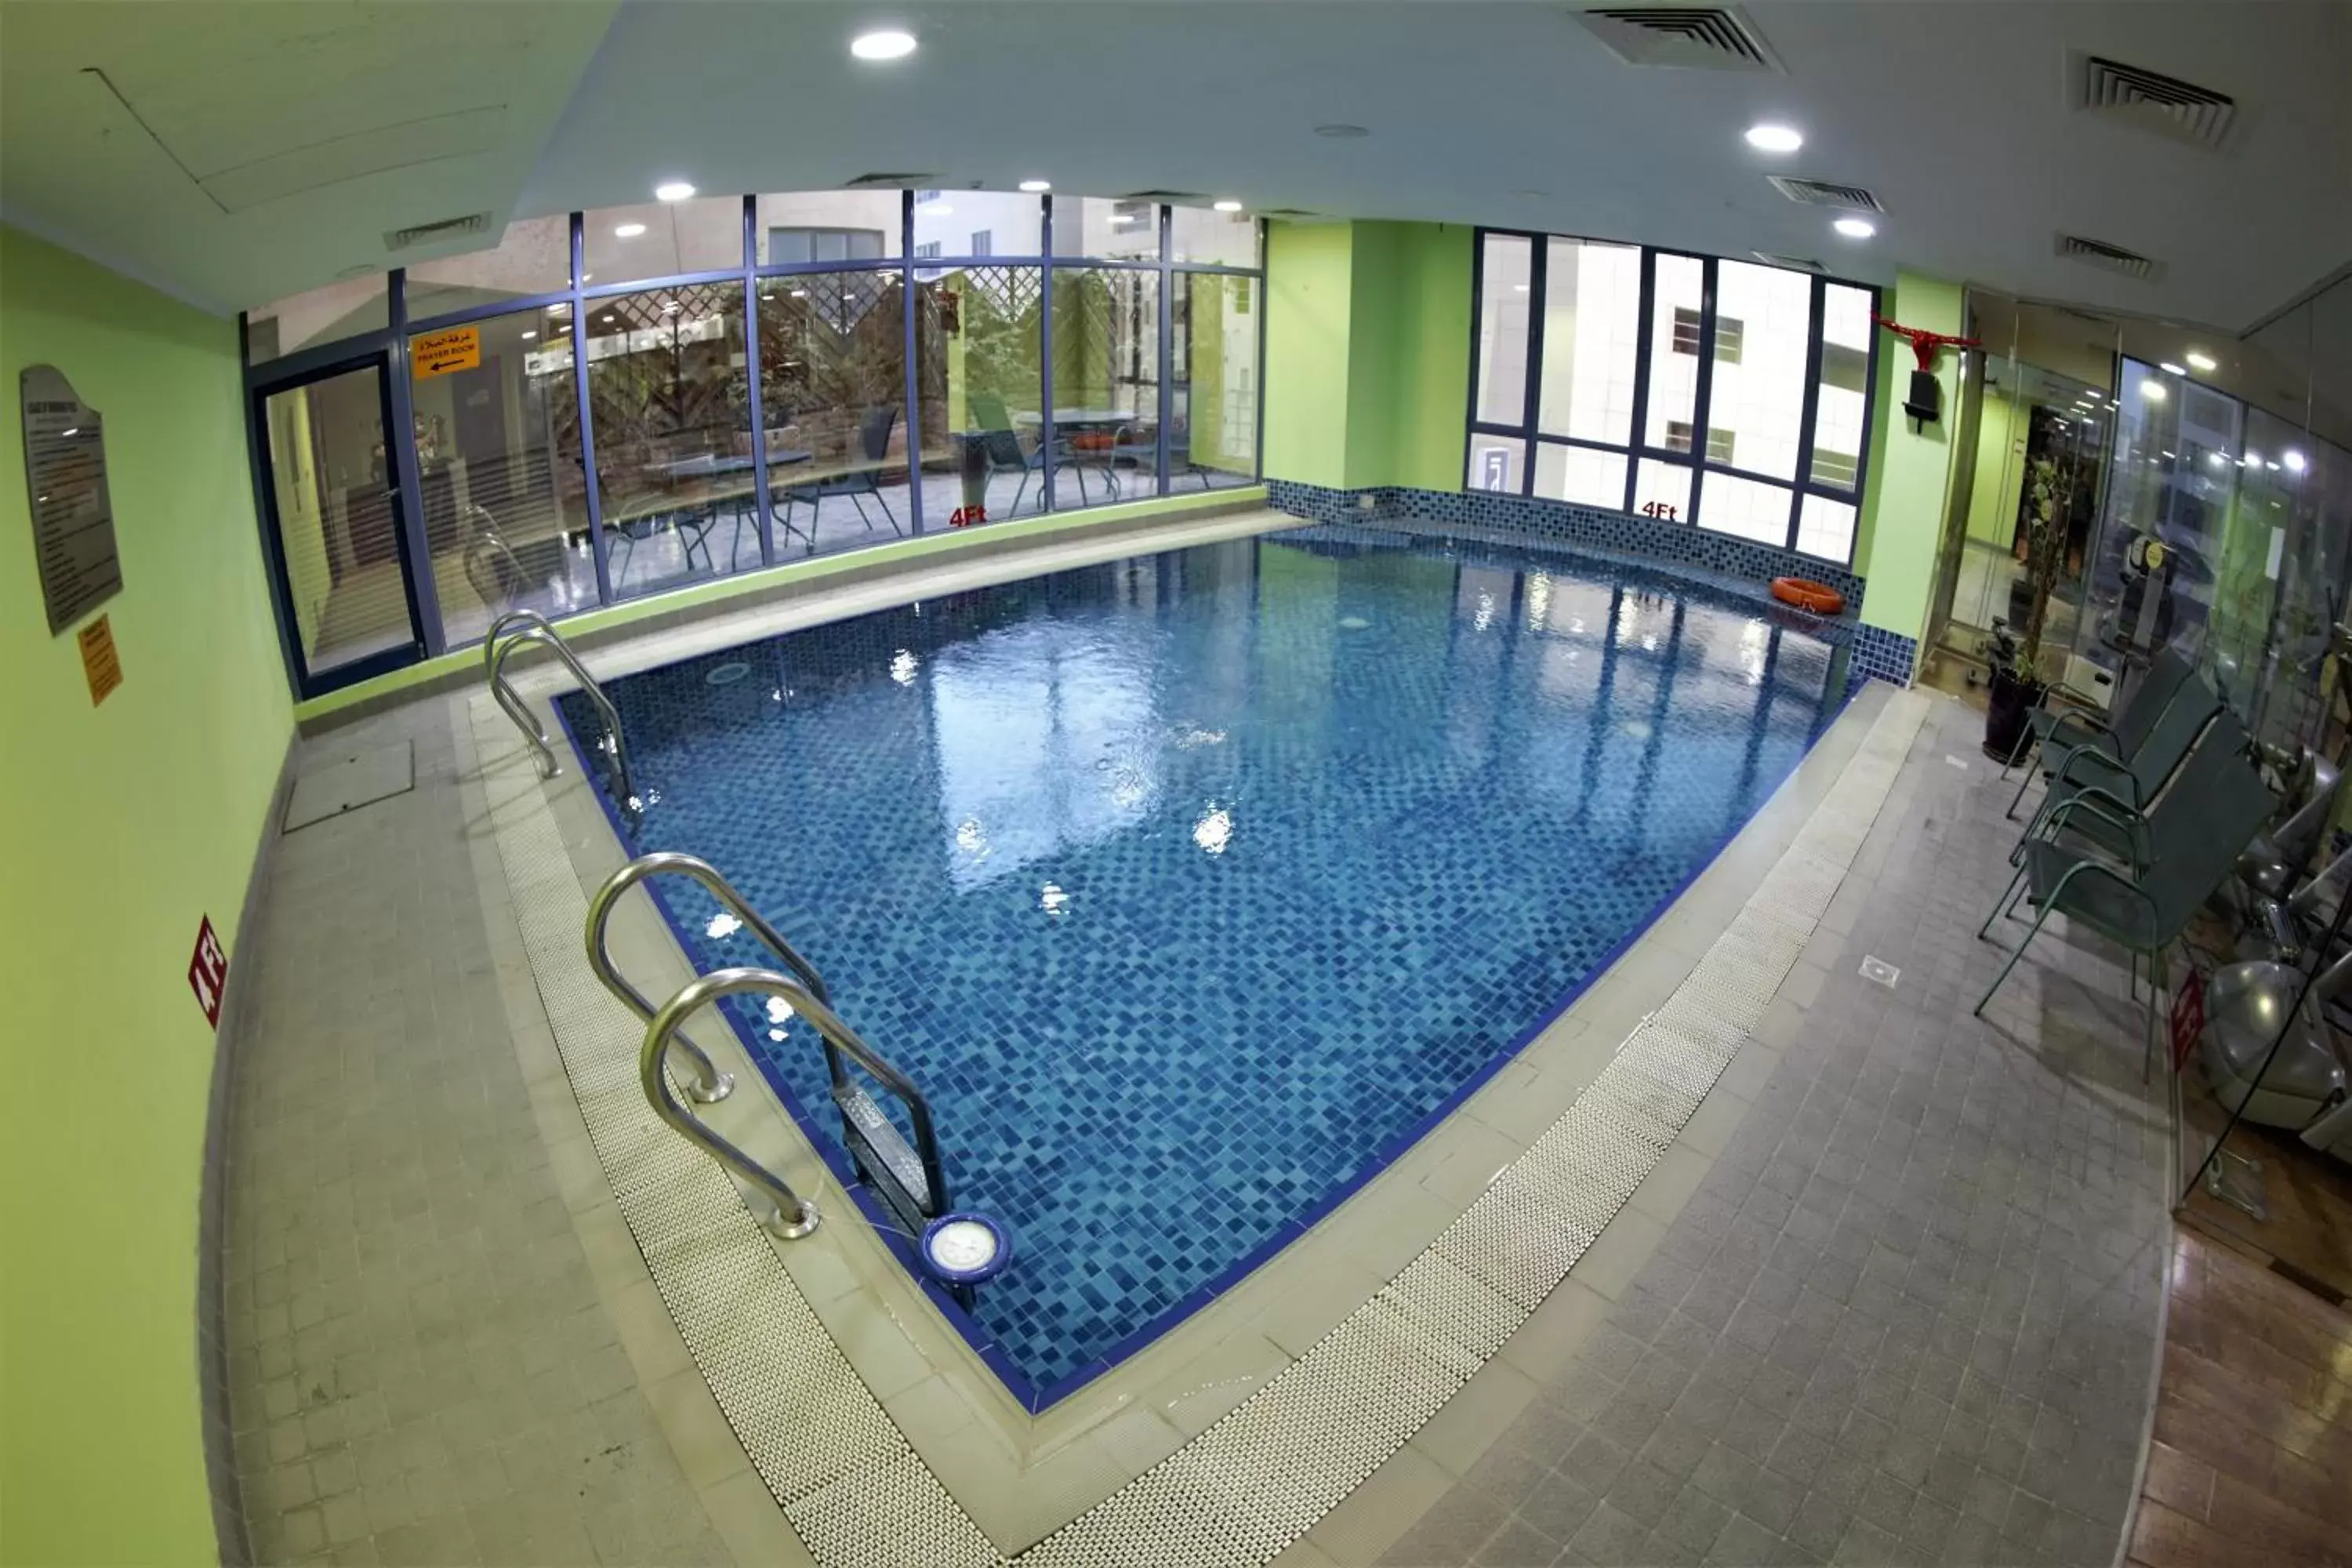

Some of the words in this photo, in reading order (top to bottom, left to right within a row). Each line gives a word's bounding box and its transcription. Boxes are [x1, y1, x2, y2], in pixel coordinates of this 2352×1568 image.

[417, 350, 449, 364] PRAYER
[451, 343, 476, 355] ROOM
[949, 504, 988, 528] 4Ft
[1641, 501, 1678, 522] 4Ft
